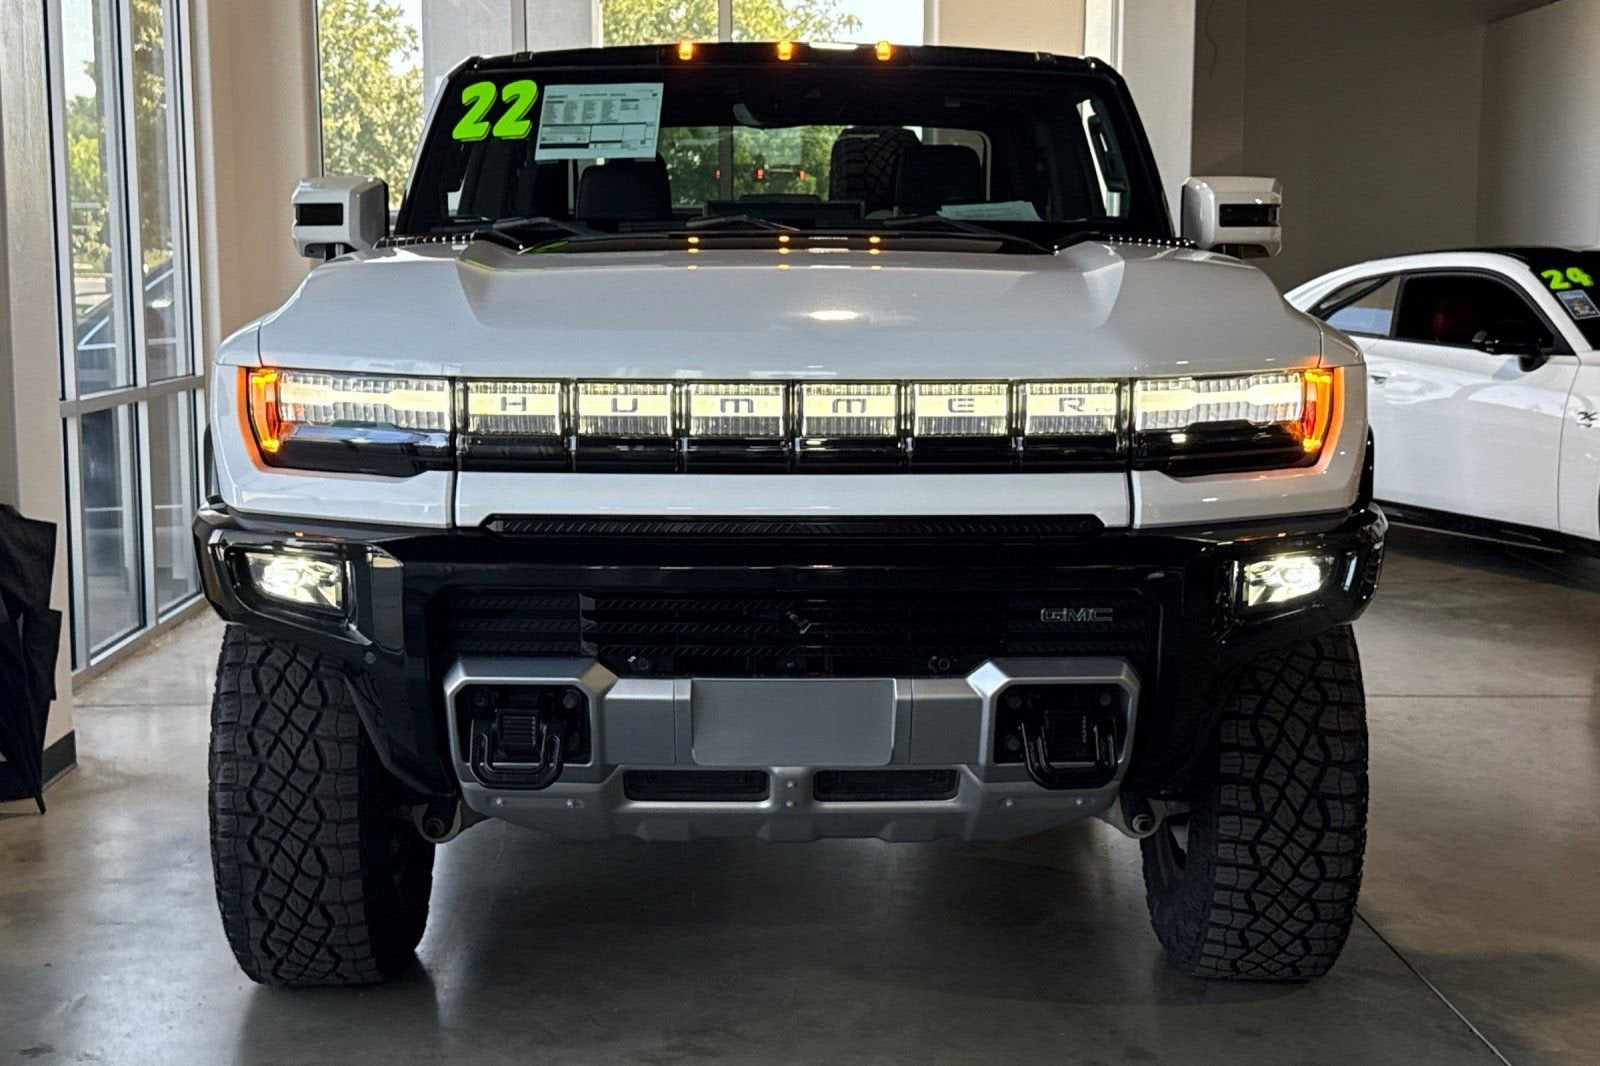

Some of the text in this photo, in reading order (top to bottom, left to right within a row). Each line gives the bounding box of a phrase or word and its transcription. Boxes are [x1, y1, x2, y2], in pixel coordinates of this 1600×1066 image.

[452, 79, 538, 142] 22
[501, 396, 1085, 413] HUMMER
[1040, 607, 1113, 622] GMC
